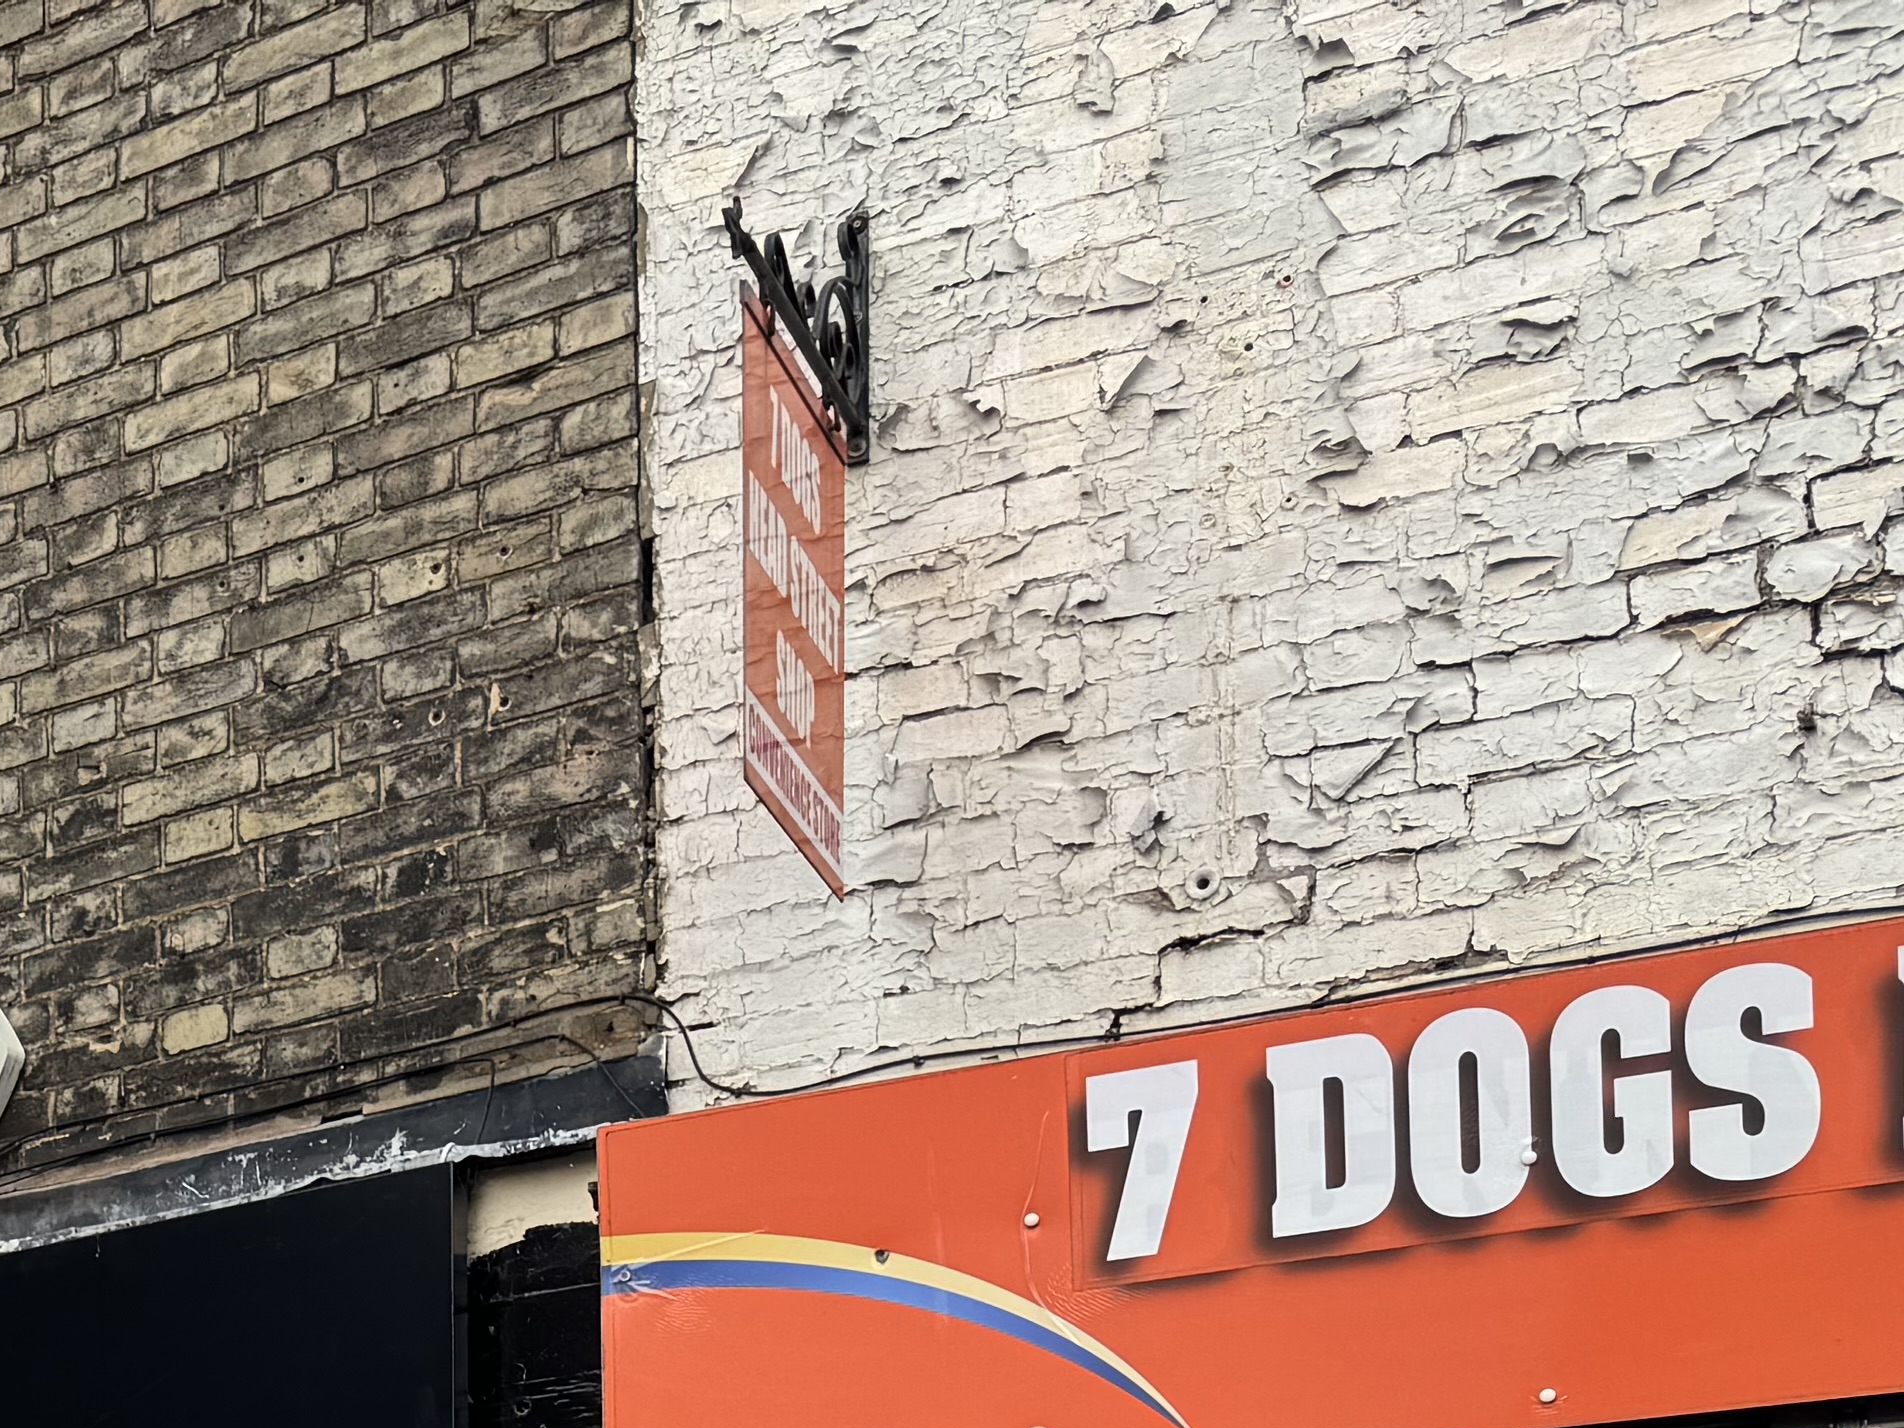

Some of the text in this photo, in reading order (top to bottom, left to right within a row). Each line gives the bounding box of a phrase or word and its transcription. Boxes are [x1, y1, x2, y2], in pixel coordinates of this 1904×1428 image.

[769, 384, 821, 536] 7 DOGS
[748, 469, 841, 676] HEAD STREET
[776, 628, 815, 750] SHOP
[1085, 1058, 1199, 1263] 7
[1265, 961, 1822, 1239] DOGS
